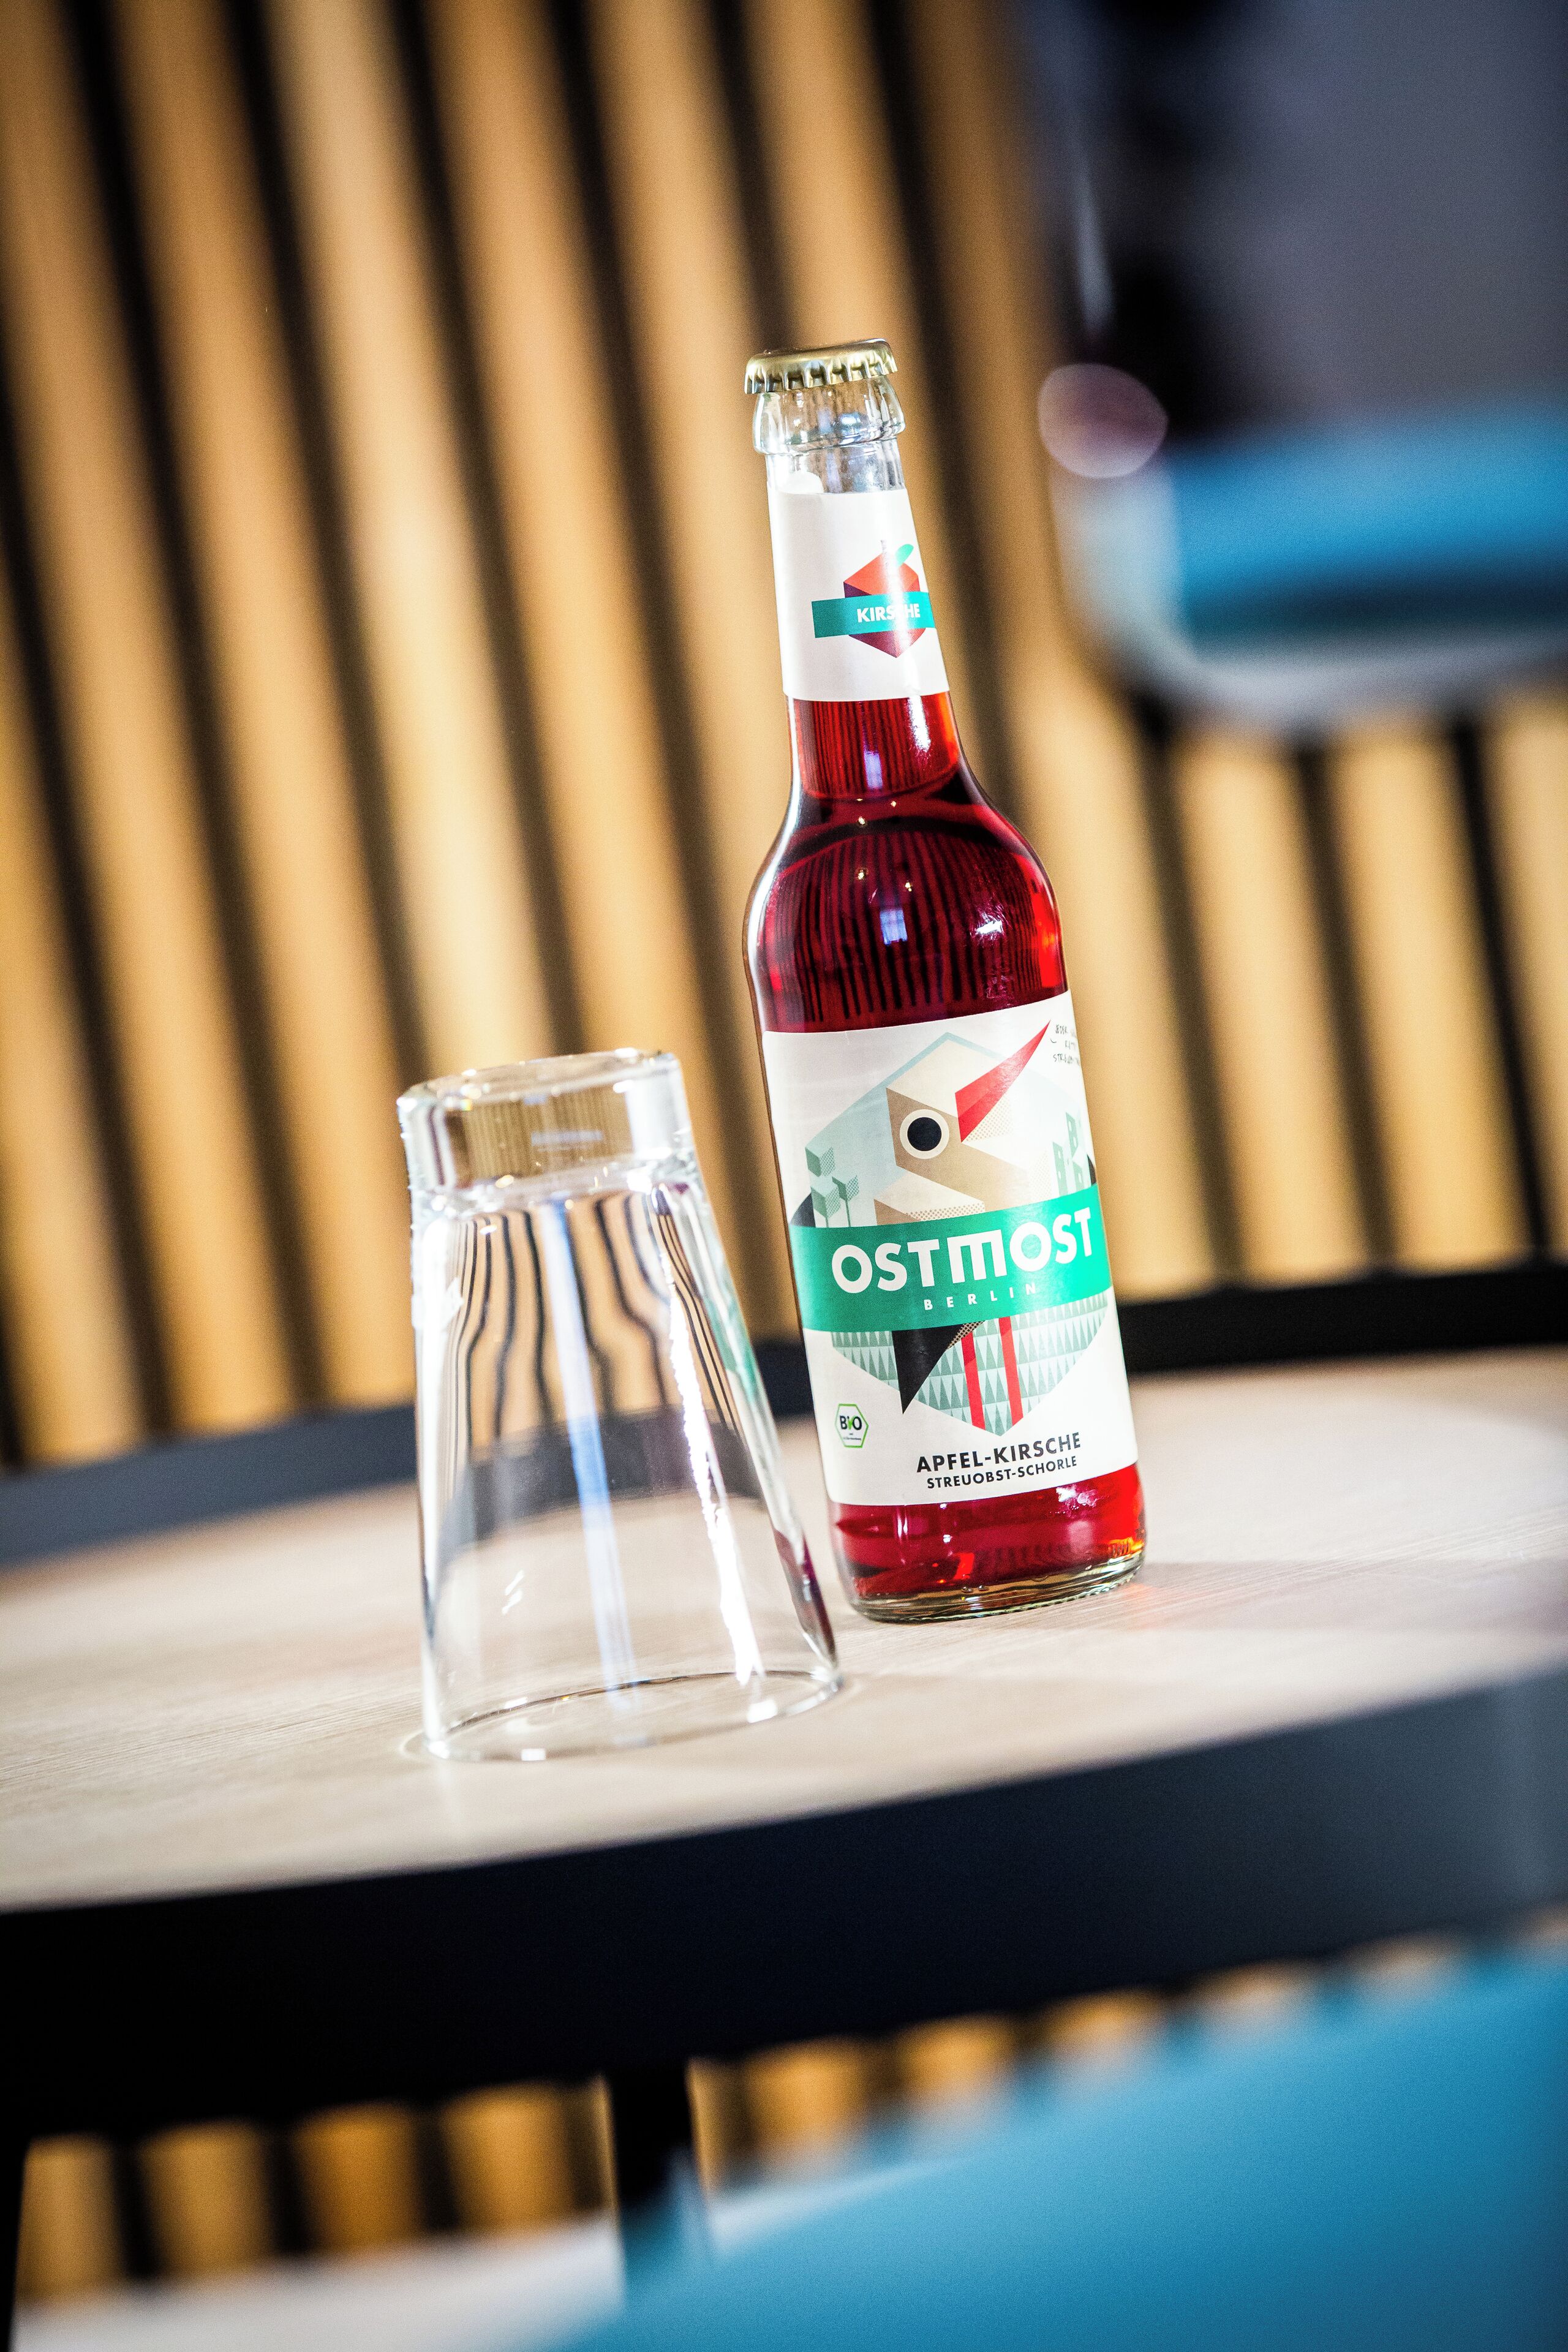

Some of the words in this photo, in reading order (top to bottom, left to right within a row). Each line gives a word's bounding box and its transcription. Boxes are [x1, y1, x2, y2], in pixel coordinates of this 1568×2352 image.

[857, 603, 921, 623] KIRSHE
[831, 1207, 1093, 1294] OSTMOST
[924, 1283, 1036, 1311] BERLIN
[916, 1432, 1081, 1473] APFEL-KIRSCHE
[927, 1455, 1077, 1489] STREUOBST-SCHORLE
